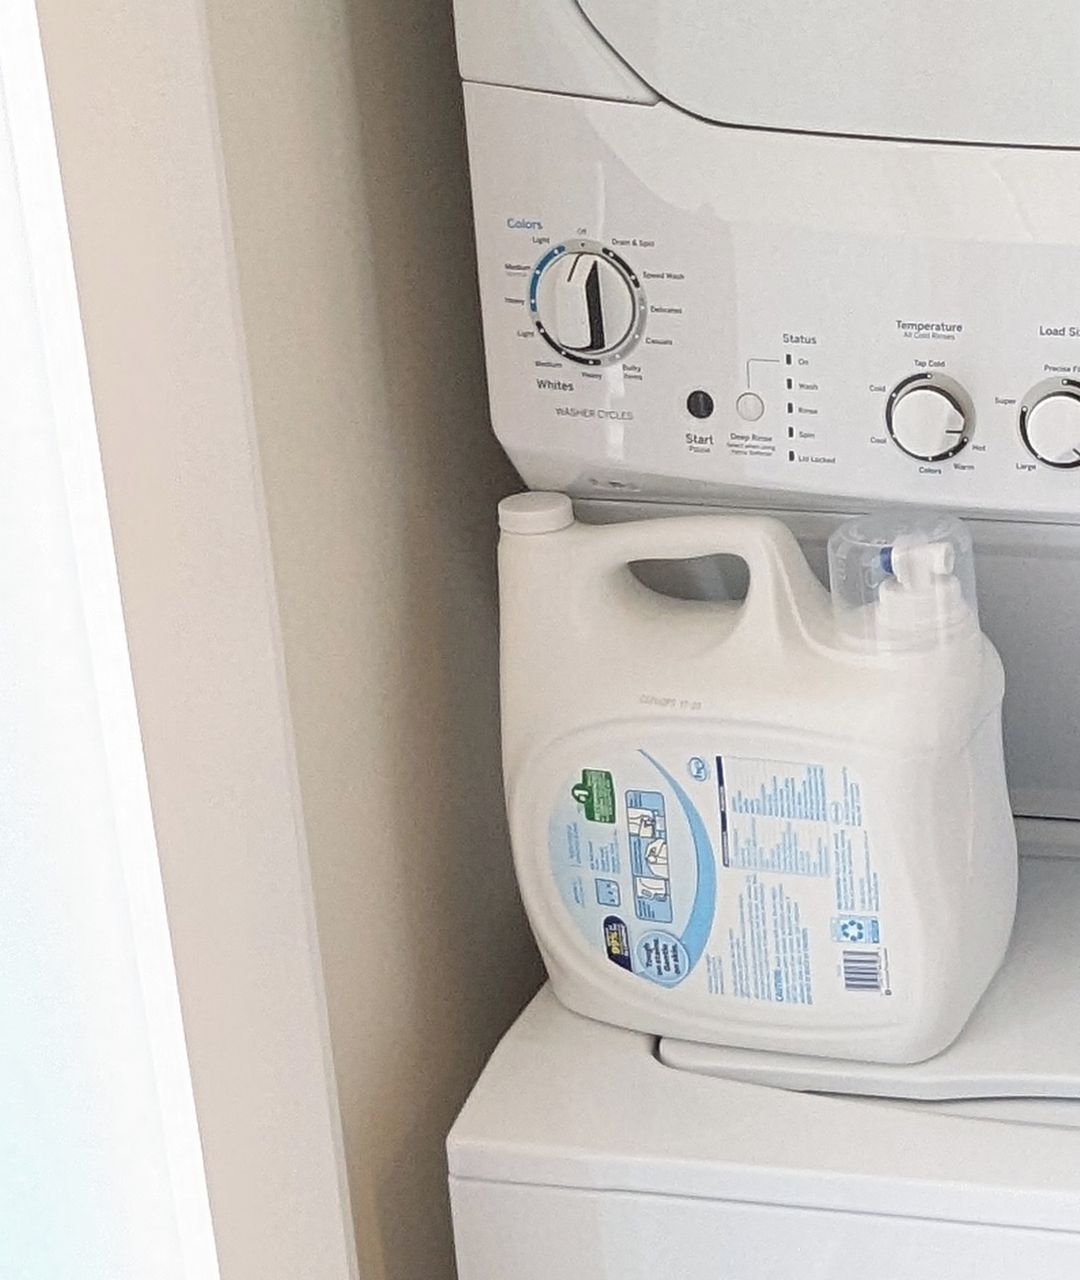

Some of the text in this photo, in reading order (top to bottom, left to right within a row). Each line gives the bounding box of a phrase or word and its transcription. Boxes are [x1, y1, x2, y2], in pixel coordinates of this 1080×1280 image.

[507, 218, 543, 230] Colors
[897, 320, 963, 332] Temperature
[1040, 326, 1065, 336] Load
[783, 334, 817, 344] Status
[536, 378, 574, 391] Whites
[555, 408, 633, 419] WASHER CYCLES
[686, 434, 714, 445] Start
[643, 942, 653, 968] Tough
[662, 943, 671, 972] Gentle
